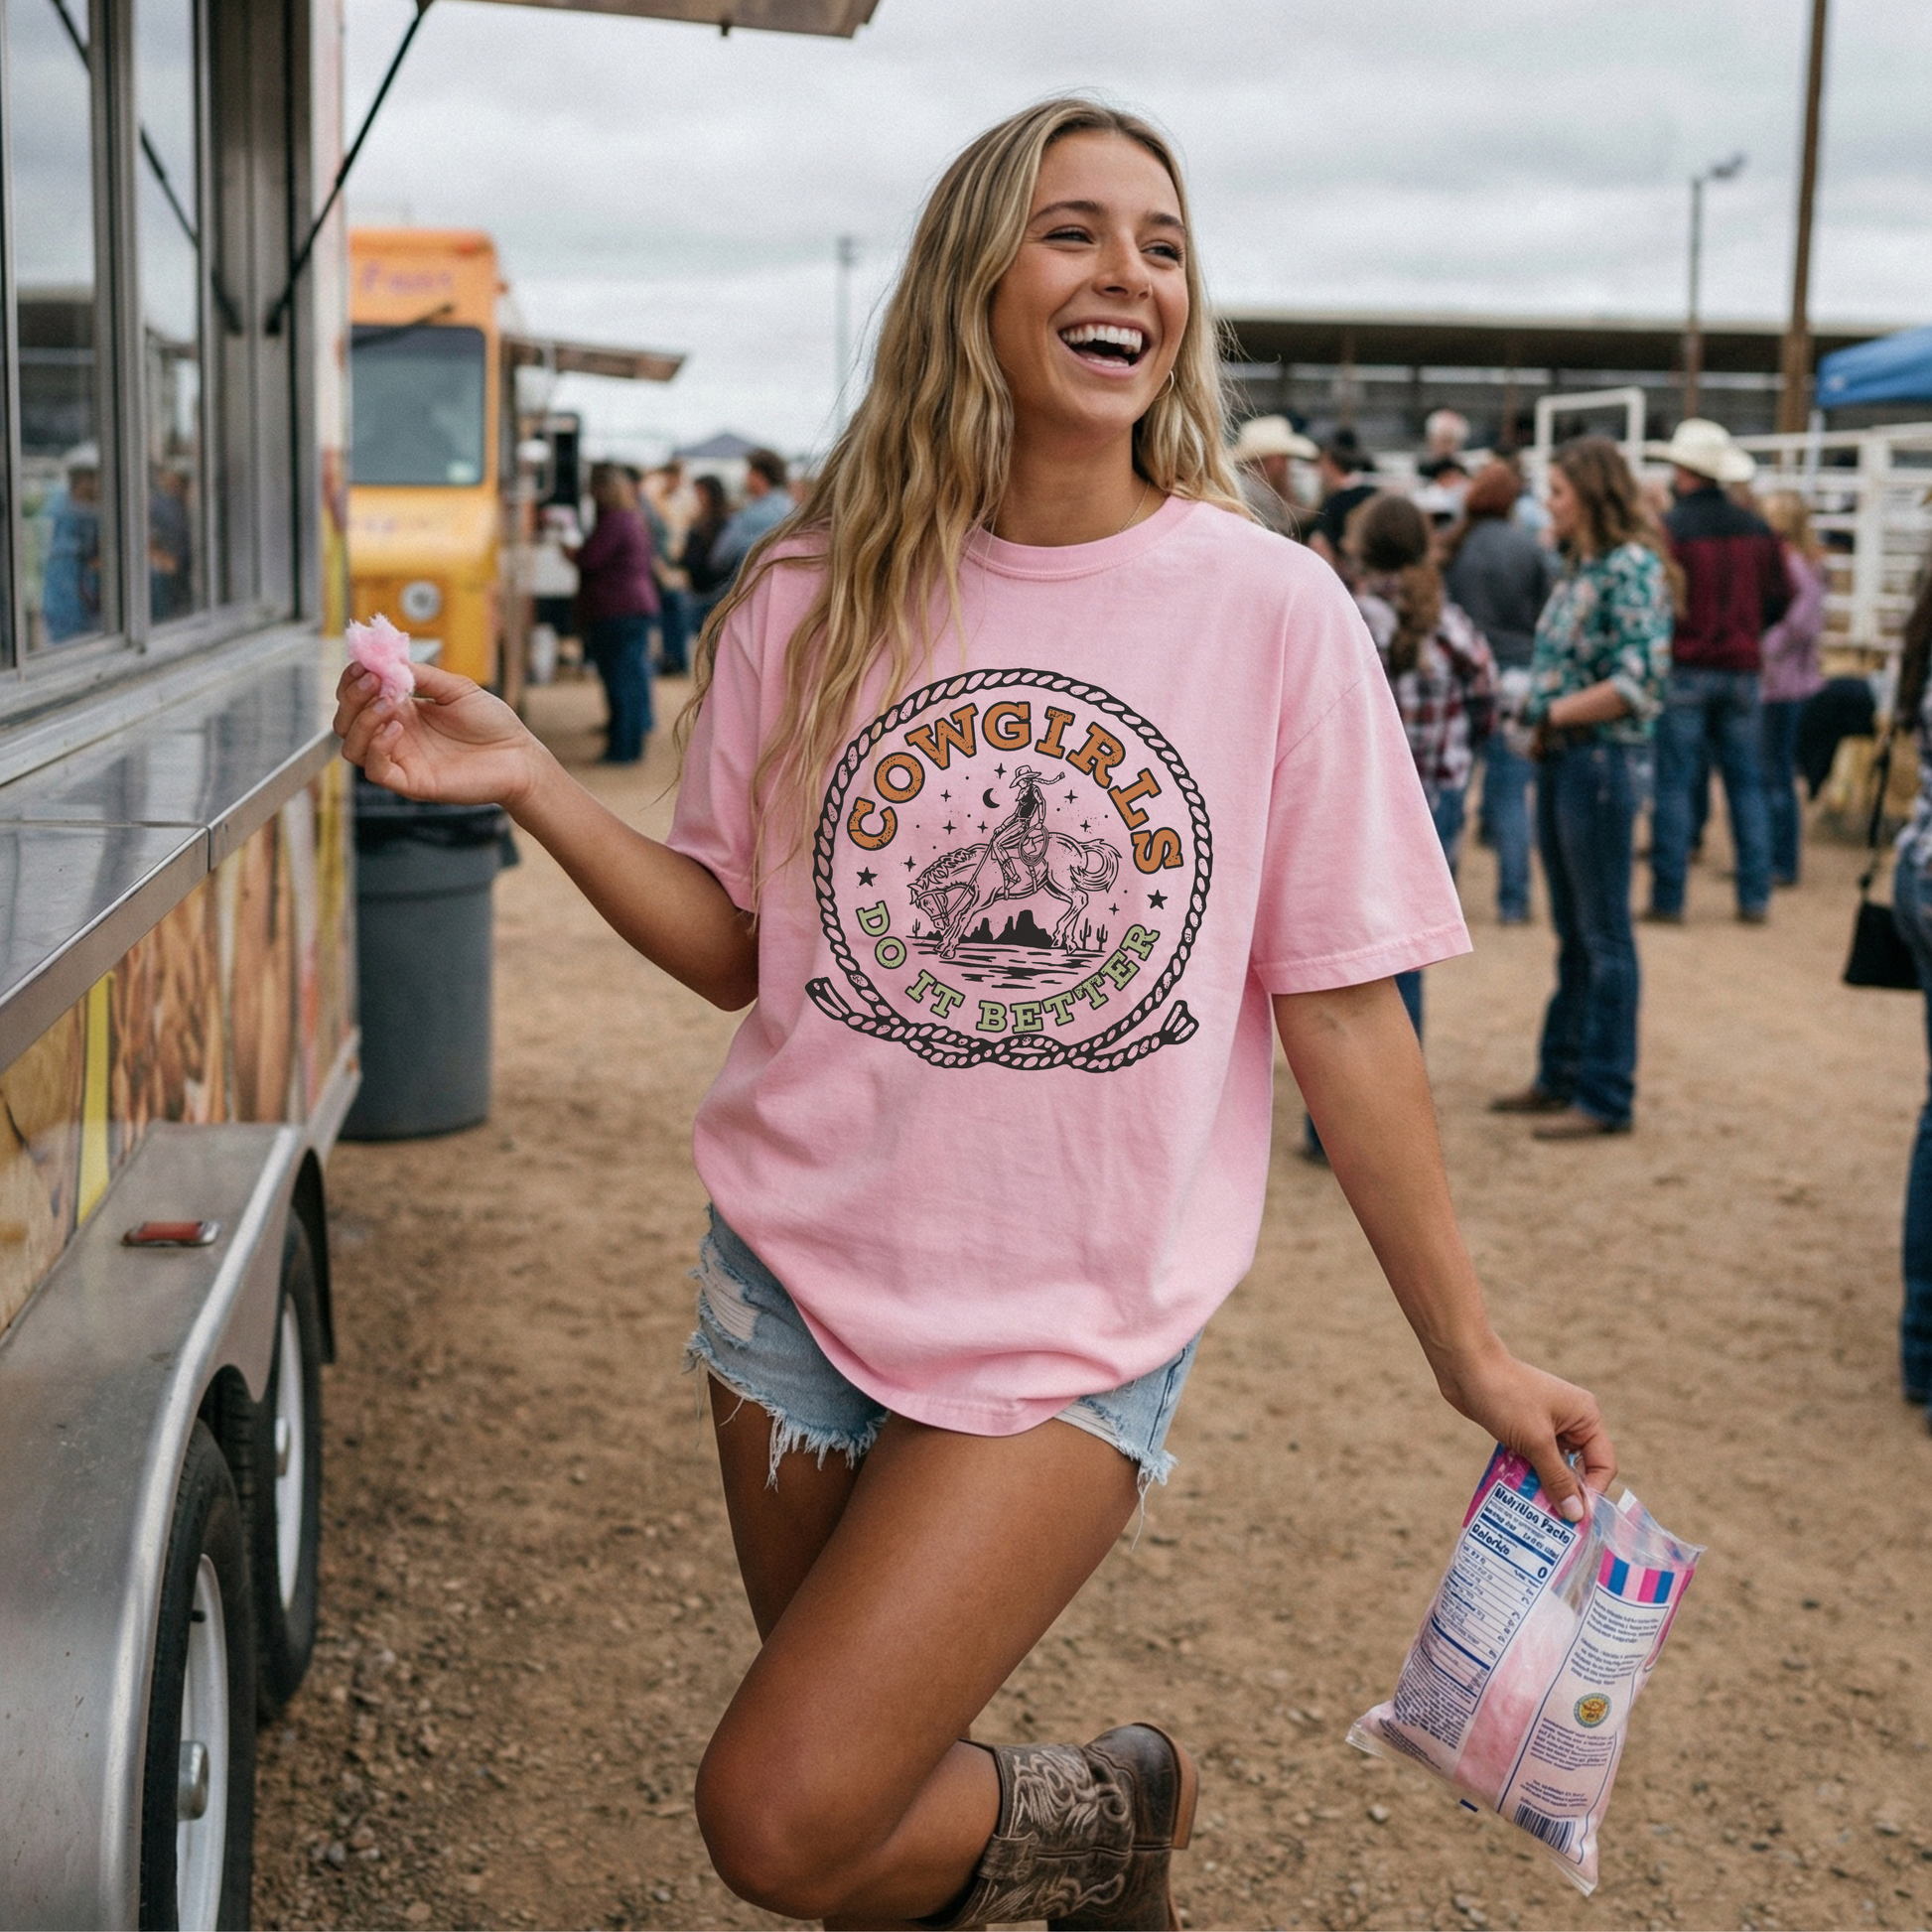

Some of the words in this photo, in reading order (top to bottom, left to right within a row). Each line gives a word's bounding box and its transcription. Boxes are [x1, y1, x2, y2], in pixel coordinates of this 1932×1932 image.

[847, 701, 1183, 875] COWGIRLS
[856, 900, 907, 969] DO
[905, 969, 965, 1019] IT
[975, 923, 1161, 1035] BETTER
